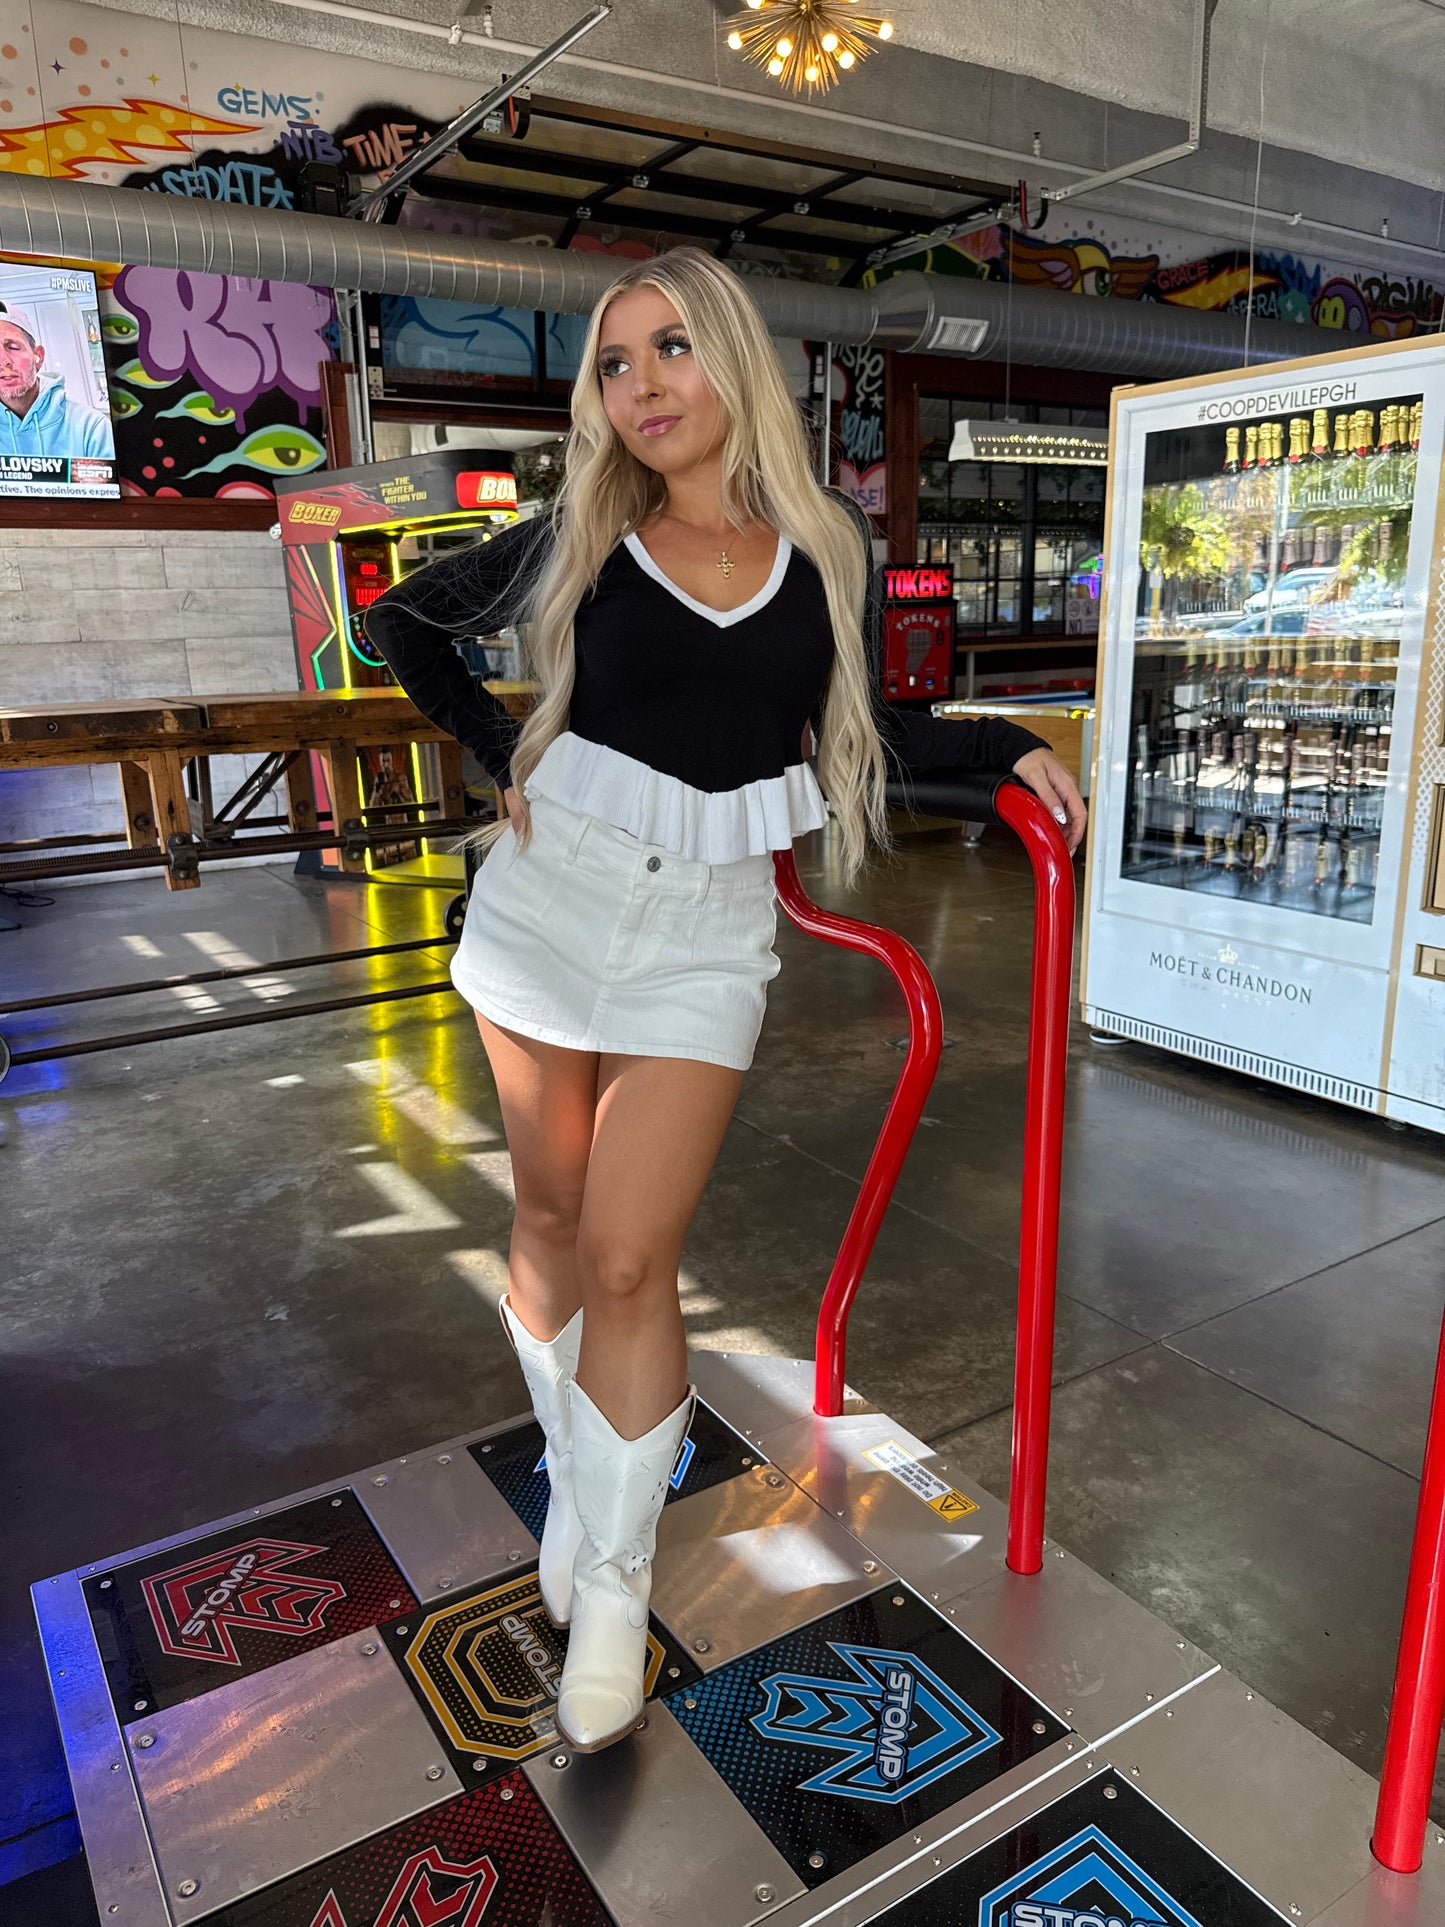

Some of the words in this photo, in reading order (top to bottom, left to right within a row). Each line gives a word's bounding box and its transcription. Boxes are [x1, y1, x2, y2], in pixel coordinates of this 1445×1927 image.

[1156, 258, 1210, 290] GRACE
[51, 276, 92, 293] #PMSLIVE
[1198, 382, 1357, 421] #COOPDEVILLEPGH
[0, 457, 63, 473] LOVSKY
[4, 471, 33, 480] LEGEND
[395, 476, 410, 486] THE
[24, 485, 43, 494] The
[45, 486, 87, 497] opinions
[381, 484, 414, 497] FIGHTER
[384, 493, 410, 505] WITHIN
[411, 491, 427, 502] YOU
[290, 502, 341, 525] BOXER
[884, 569, 952, 598] TOKENS
[896, 613, 940, 632] TOKENS
[1149, 951, 1198, 976] MOËT
[1201, 967, 1212, 981] &
[1216, 967, 1313, 1005] CHANDON
[180, 1552, 256, 1637] STOMP
[878, 1669, 912, 1779] STOMP
